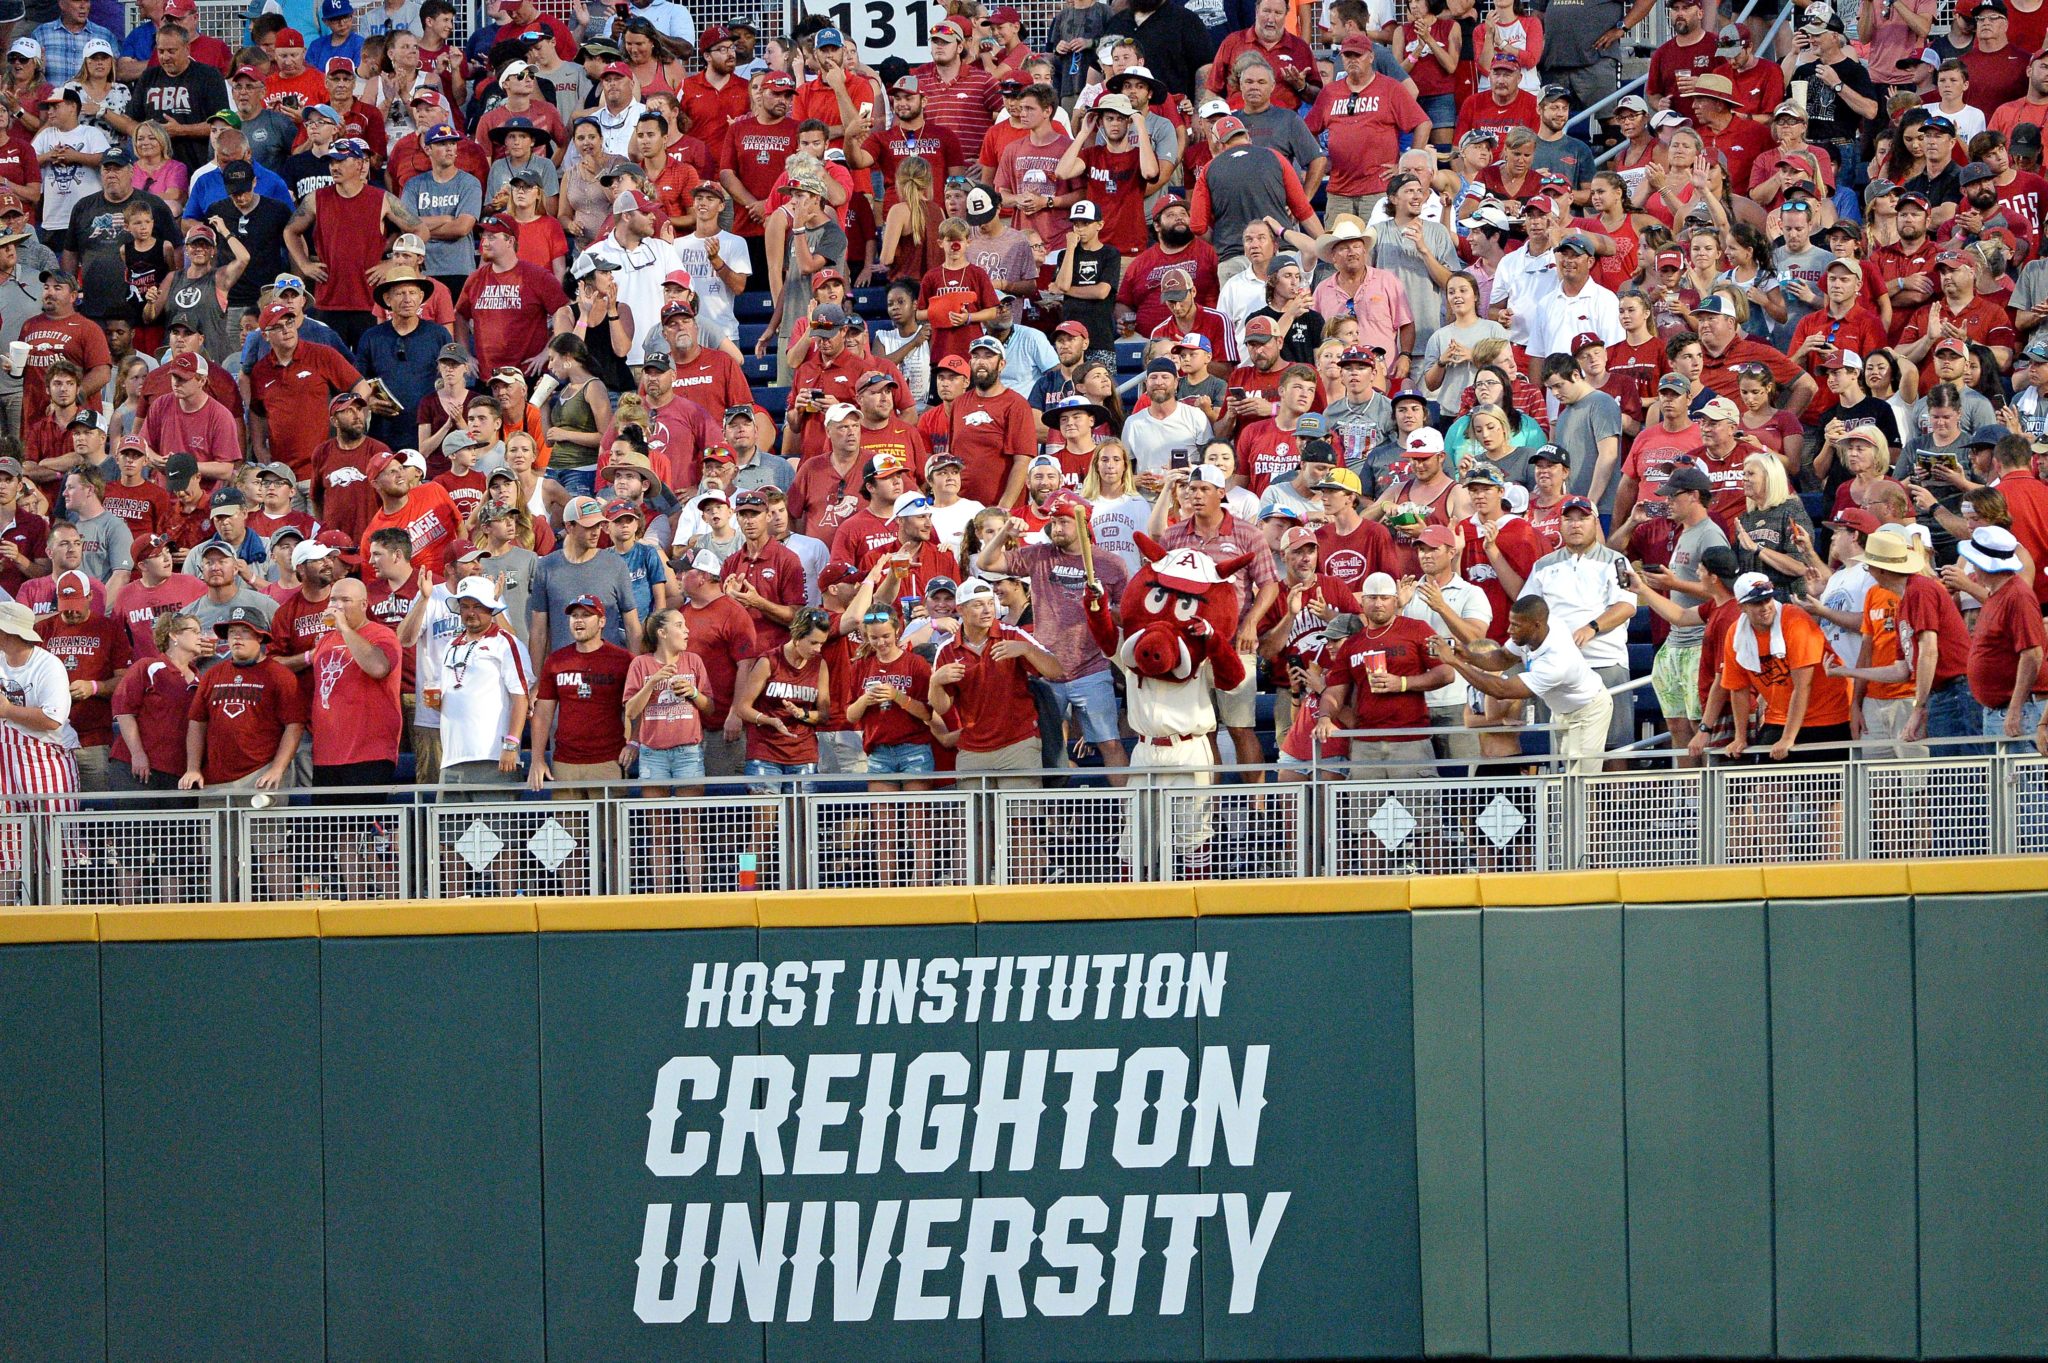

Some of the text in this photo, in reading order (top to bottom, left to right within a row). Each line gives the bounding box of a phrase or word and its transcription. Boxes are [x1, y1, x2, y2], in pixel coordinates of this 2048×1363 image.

[829, 0, 928, 48] 131
[147, 86, 191, 111] GBR
[1330, 95, 1379, 116] ARKNSAS
[742, 135, 790, 145] ARKANSAS
[744, 142, 785, 152] BASEBALL
[1074, 204, 1086, 215] B
[481, 284, 520, 299] ARKANSAS
[474, 297, 522, 310] RAZORBACKS
[1176, 552, 1197, 569] A
[47, 635, 101, 649] ARKANSAS
[50, 646, 95, 656] BASEBALL
[684, 951, 1229, 1028] HOST INSTITUTION
[645, 1045, 1271, 1177] CREIGHTON
[633, 1191, 1292, 1324] UNIVERSITY
